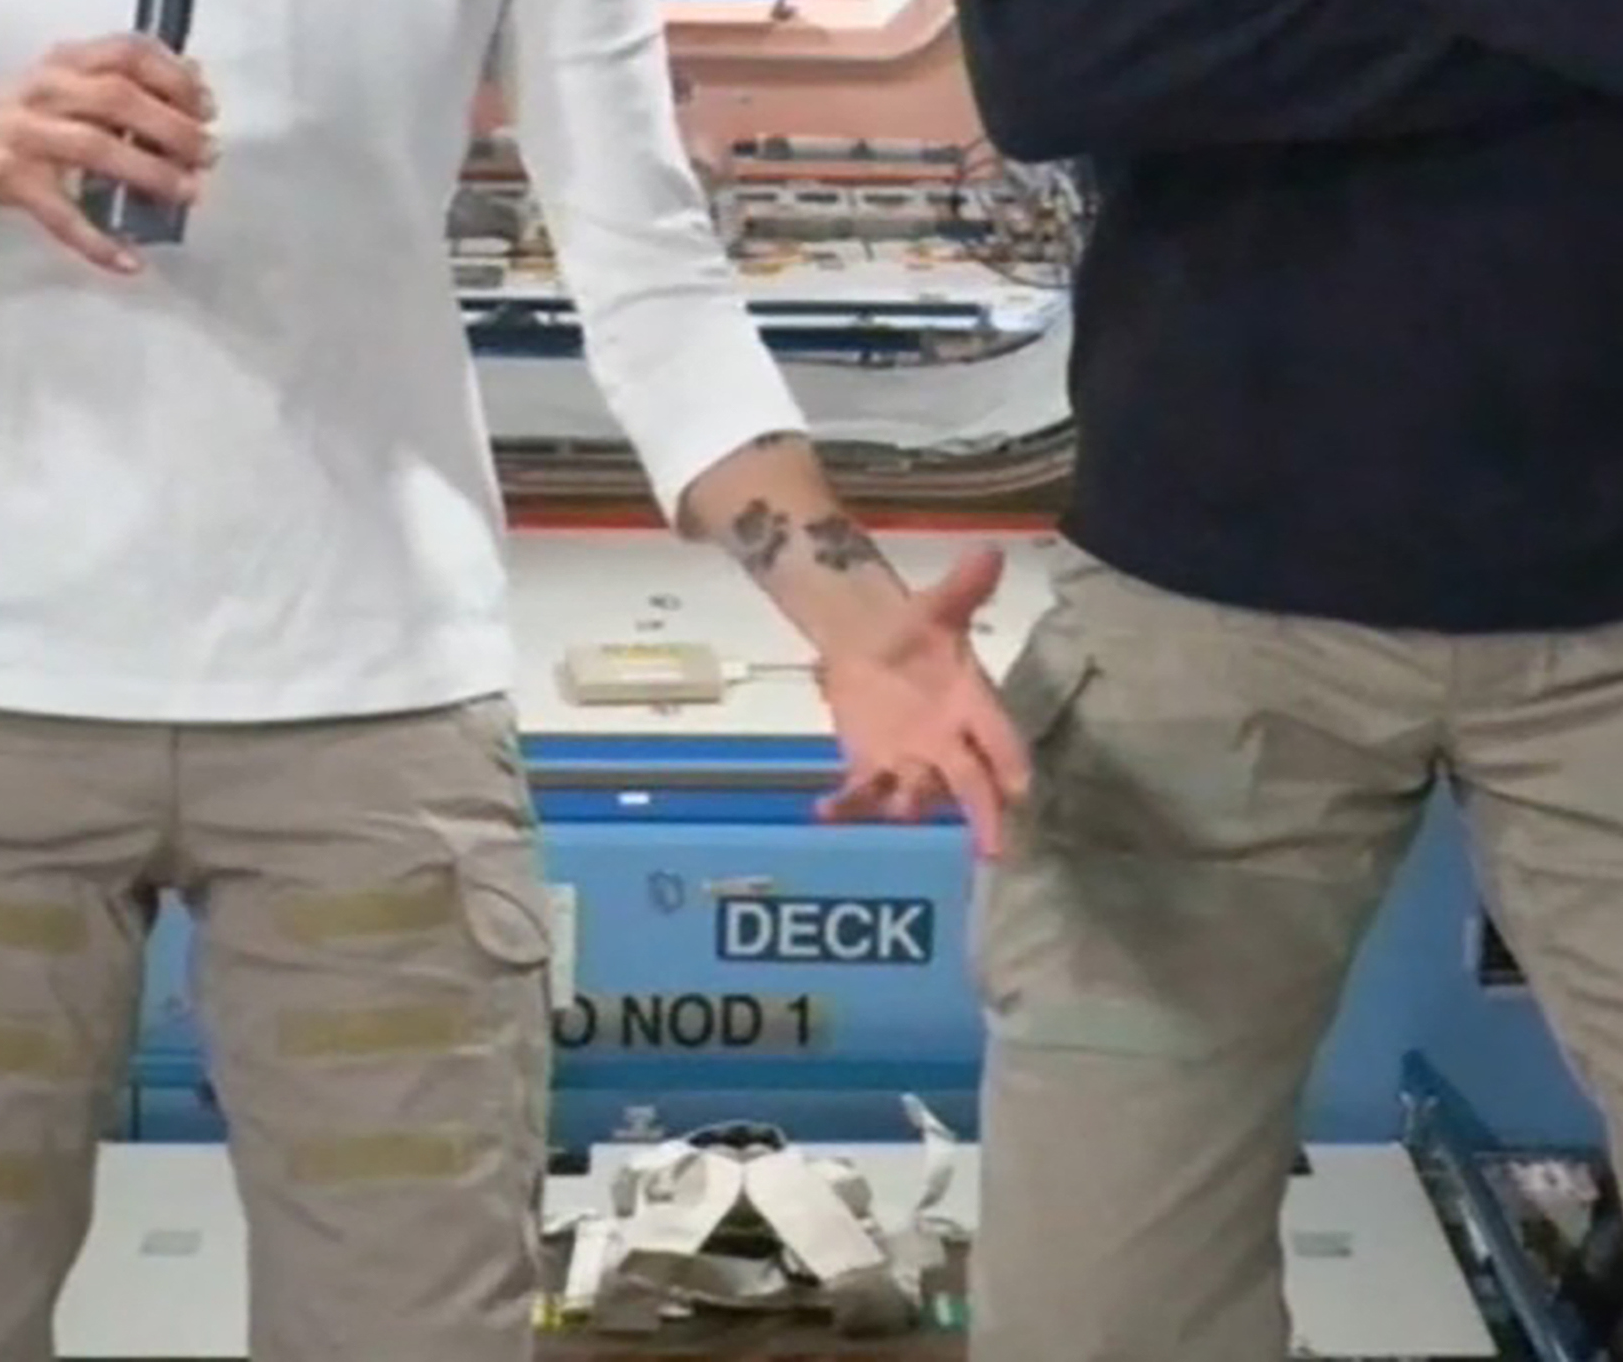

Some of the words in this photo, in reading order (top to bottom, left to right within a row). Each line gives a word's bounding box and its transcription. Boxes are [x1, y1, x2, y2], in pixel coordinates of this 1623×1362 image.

[724, 902, 925, 959] DECK
[621, 994, 762, 1047] NOD
[786, 995, 812, 1045] 1
